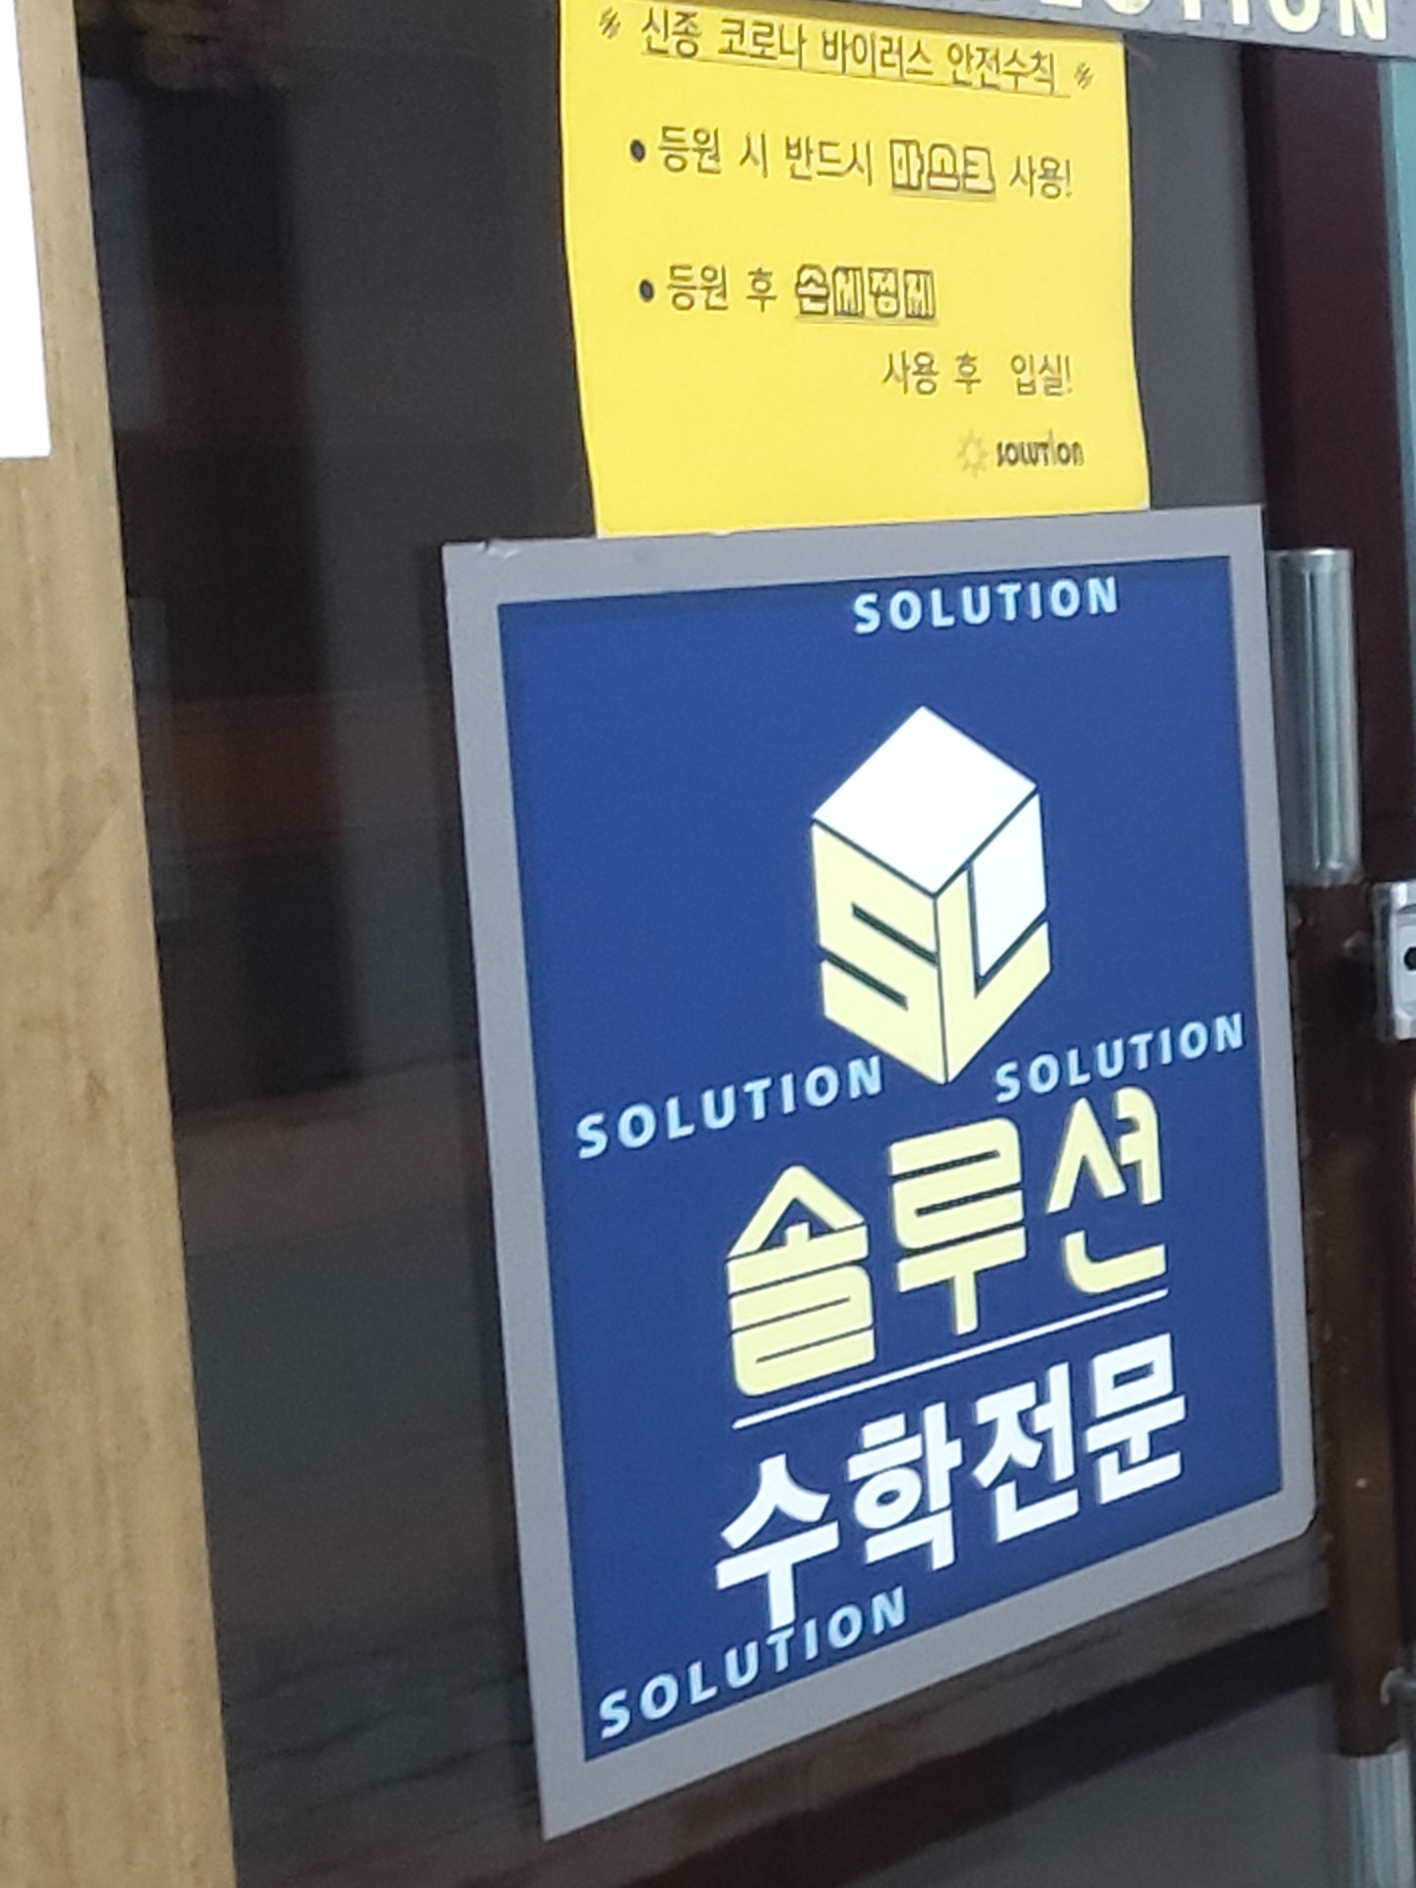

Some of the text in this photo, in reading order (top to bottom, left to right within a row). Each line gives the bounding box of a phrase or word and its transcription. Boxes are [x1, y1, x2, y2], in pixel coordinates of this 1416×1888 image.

[641, 6, 1057, 93] 신종 코로나 바이러스 안전수칙
[657, 126, 1074, 200] 등원 시 반드시 마스크 사용!
[666, 264, 728, 312] 등원
[745, 267, 778, 312] 후
[882, 350, 1074, 397] 사용 후 입실!
[853, 576, 1118, 635] SOLUTION
[576, 1013, 1244, 1159] SOLUTION SOLUTION
[727, 1086, 1168, 1397] 솔루션
[716, 1333, 1186, 1632] 수학전문
[600, 1586, 907, 1739] SOLUTION
